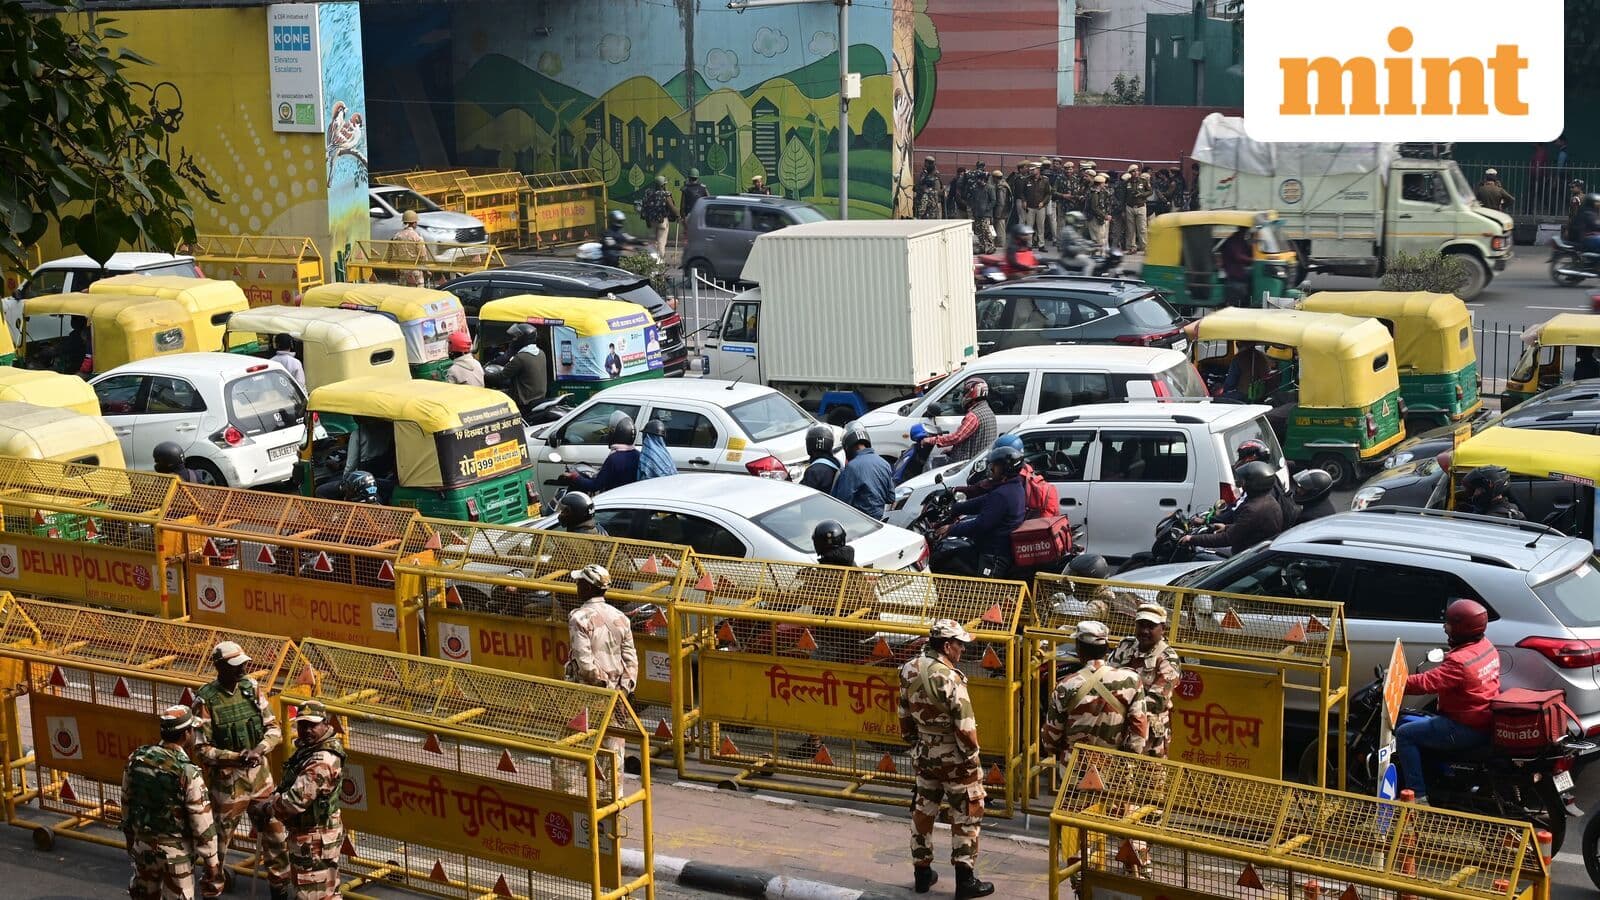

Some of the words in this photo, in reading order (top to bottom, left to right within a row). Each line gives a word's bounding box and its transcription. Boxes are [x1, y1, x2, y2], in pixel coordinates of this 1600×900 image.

[274, 33, 310, 44] KONE
[477, 458, 493, 471] 399
[1016, 541, 1051, 553] zomato
[22, 548, 69, 577] DELHI
[72, 555, 133, 587] POLICE
[243, 589, 287, 616] DELHI
[311, 600, 361, 627] POLICE
[480, 629, 533, 659] DELHI
[765, 664, 842, 706] दिल्ली
[842, 674, 900, 714] पुलि
[1182, 685, 1194, 696] 22
[862, 721, 881, 732] NEW
[886, 724, 900, 734] DEL
[1178, 703, 1264, 748] पुलिस
[1496, 727, 1540, 740] zomato
[1197, 748, 1222, 766] दिल्ली
[1380, 749, 1388, 761] P
[373, 764, 448, 818] दिल्ली
[451, 785, 539, 838] पुलिस
